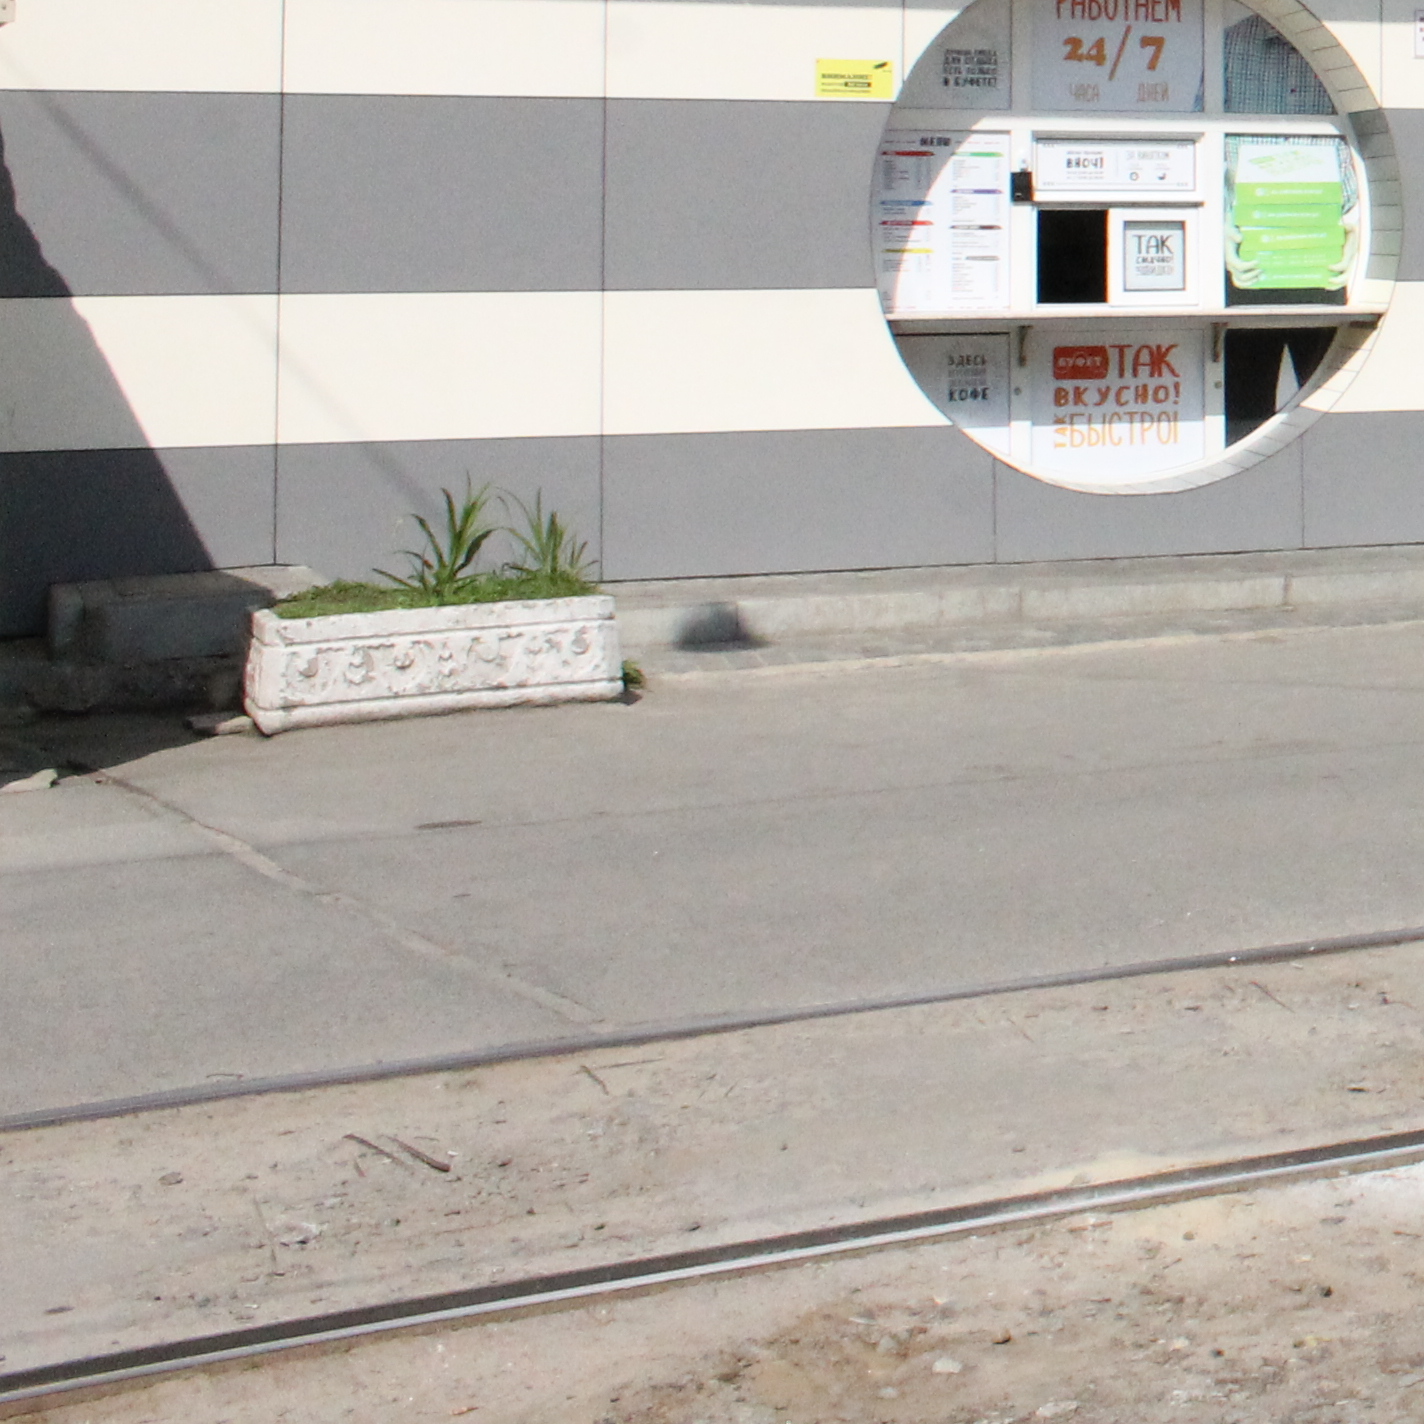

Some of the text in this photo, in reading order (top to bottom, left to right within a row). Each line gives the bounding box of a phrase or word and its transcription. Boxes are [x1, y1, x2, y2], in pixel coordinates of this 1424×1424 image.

[1132, 234, 1174, 255] ТАК
[1109, 344, 1181, 379] ТАК
[948, 387, 989, 402] КОФЕ
[1054, 381, 1181, 407] ВКУСНО!
